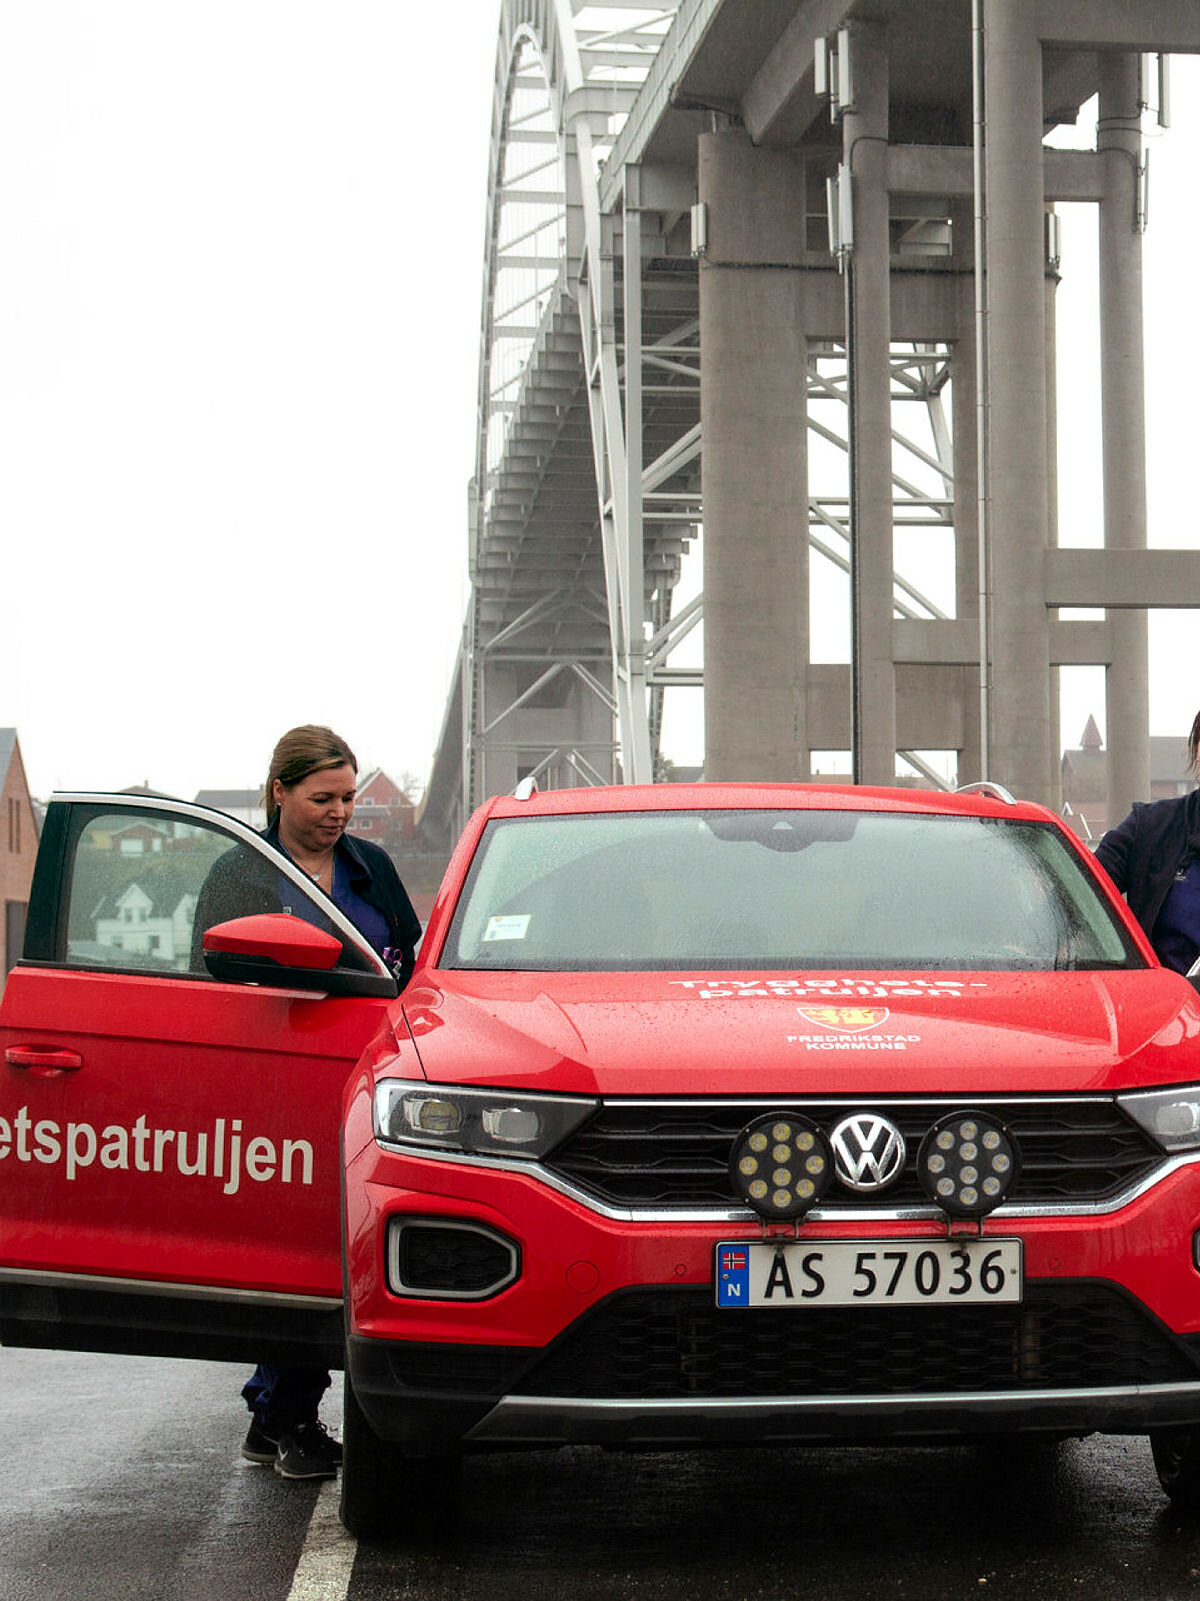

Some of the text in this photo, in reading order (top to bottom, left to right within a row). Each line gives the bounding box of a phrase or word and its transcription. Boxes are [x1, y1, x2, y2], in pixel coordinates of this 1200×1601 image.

[668, 979, 988, 989] Trygghets-
[698, 986, 962, 999] patruljen
[786, 1034, 922, 1044] FREDRIKSTAD
[806, 1042, 907, 1051] KOMMUNE
[763, 1249, 1006, 1299] AS 57036
[727, 1283, 742, 1298] N
